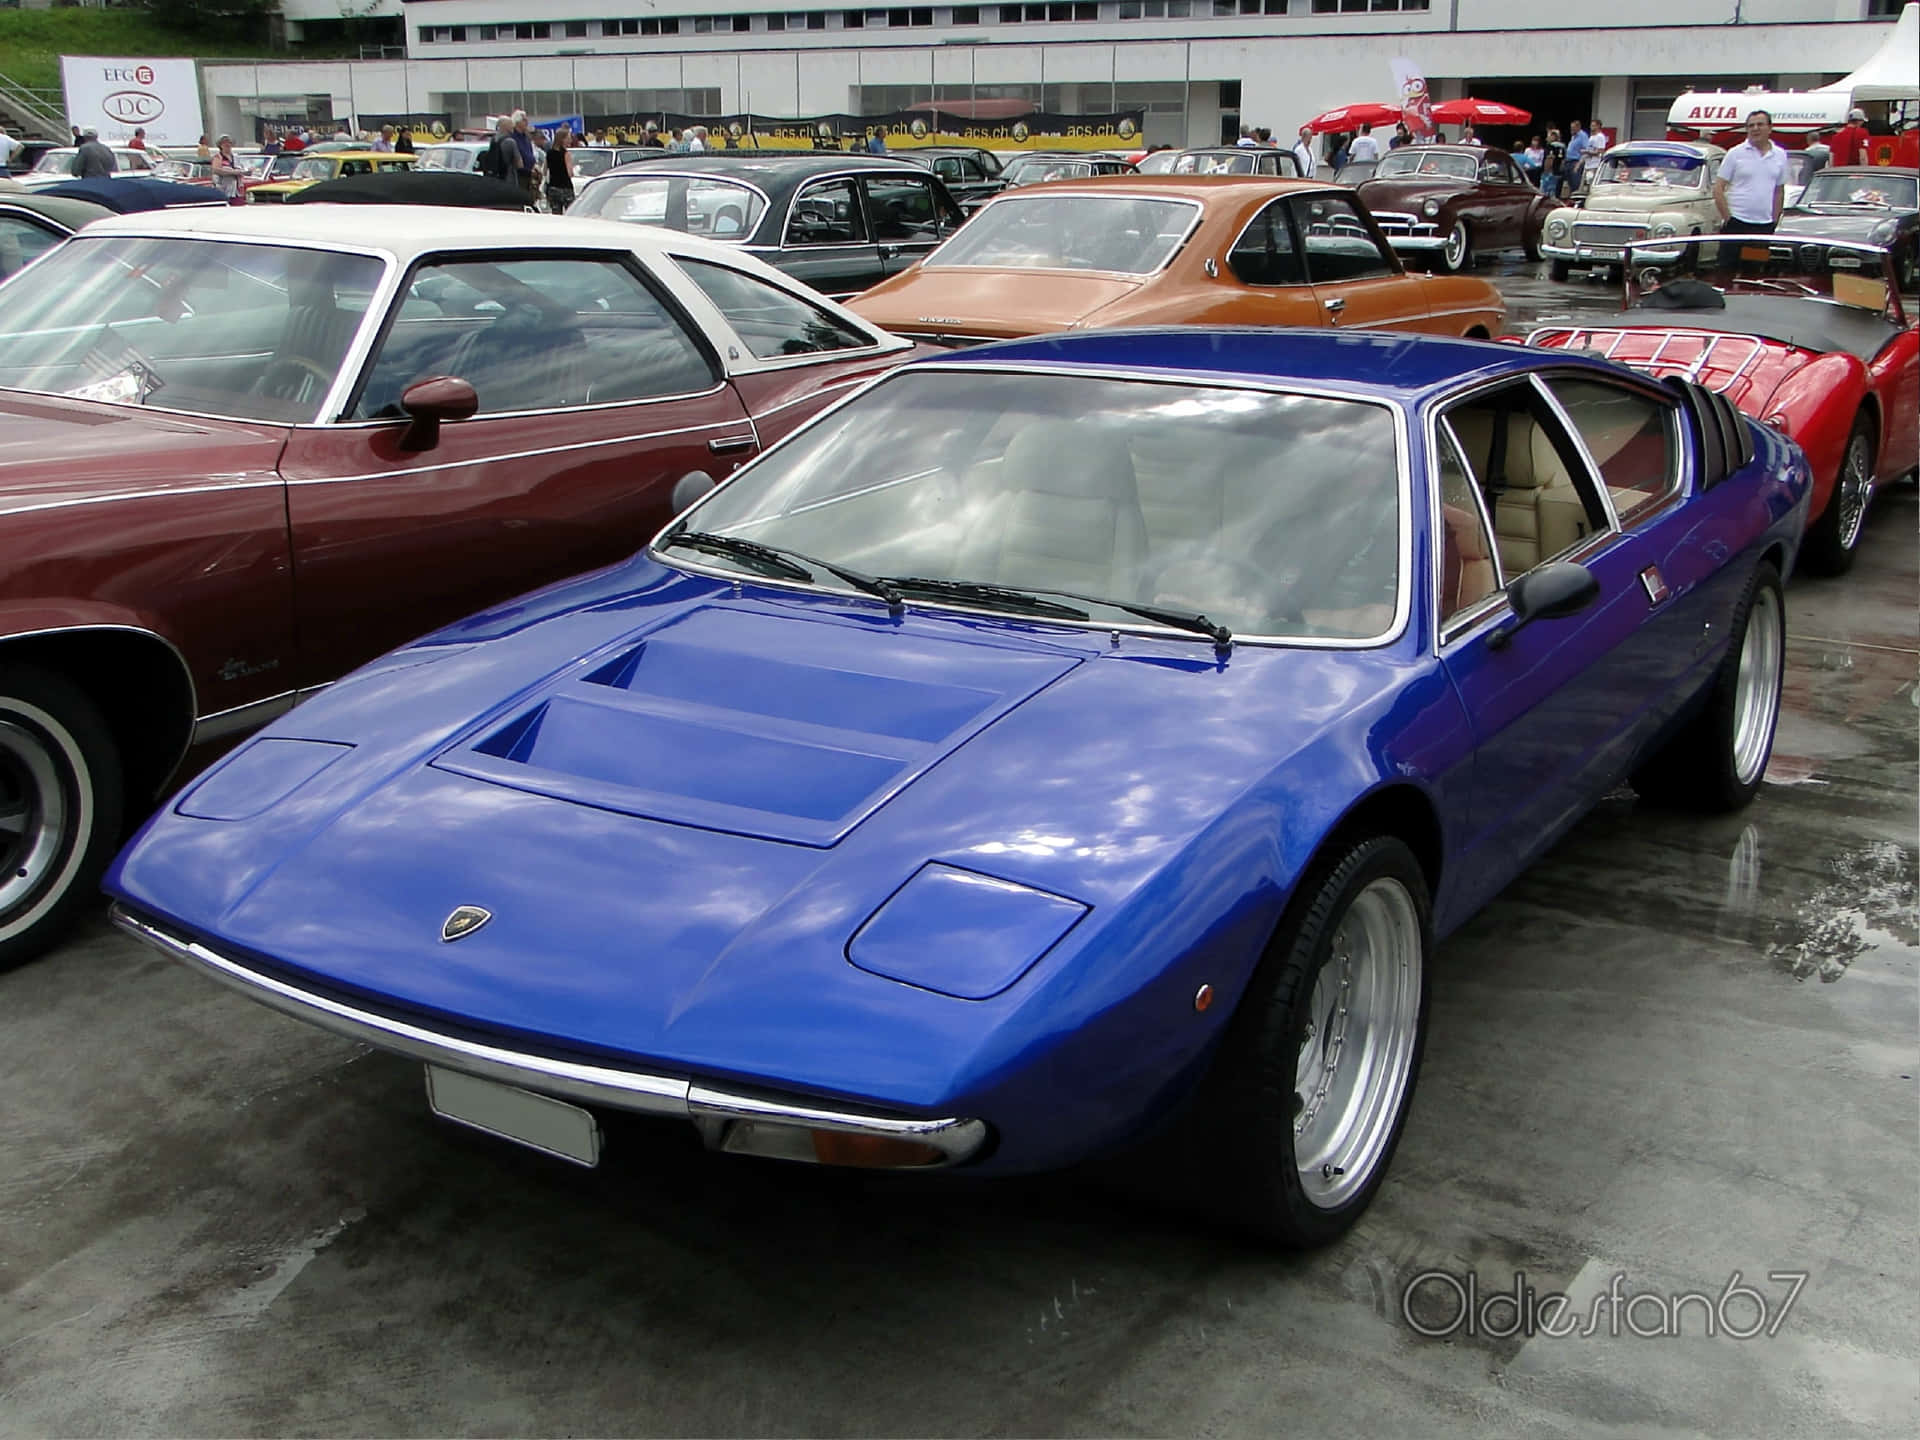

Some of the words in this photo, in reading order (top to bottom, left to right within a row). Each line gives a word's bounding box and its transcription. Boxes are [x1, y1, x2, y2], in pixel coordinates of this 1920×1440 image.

[104, 68, 134, 81] EFG
[117, 98, 152, 115] DC
[1688, 106, 1738, 119] AVIA
[865, 120, 908, 136] a.ch
[964, 125, 1009, 139] acs.ch
[1066, 122, 1115, 137] acs.ch
